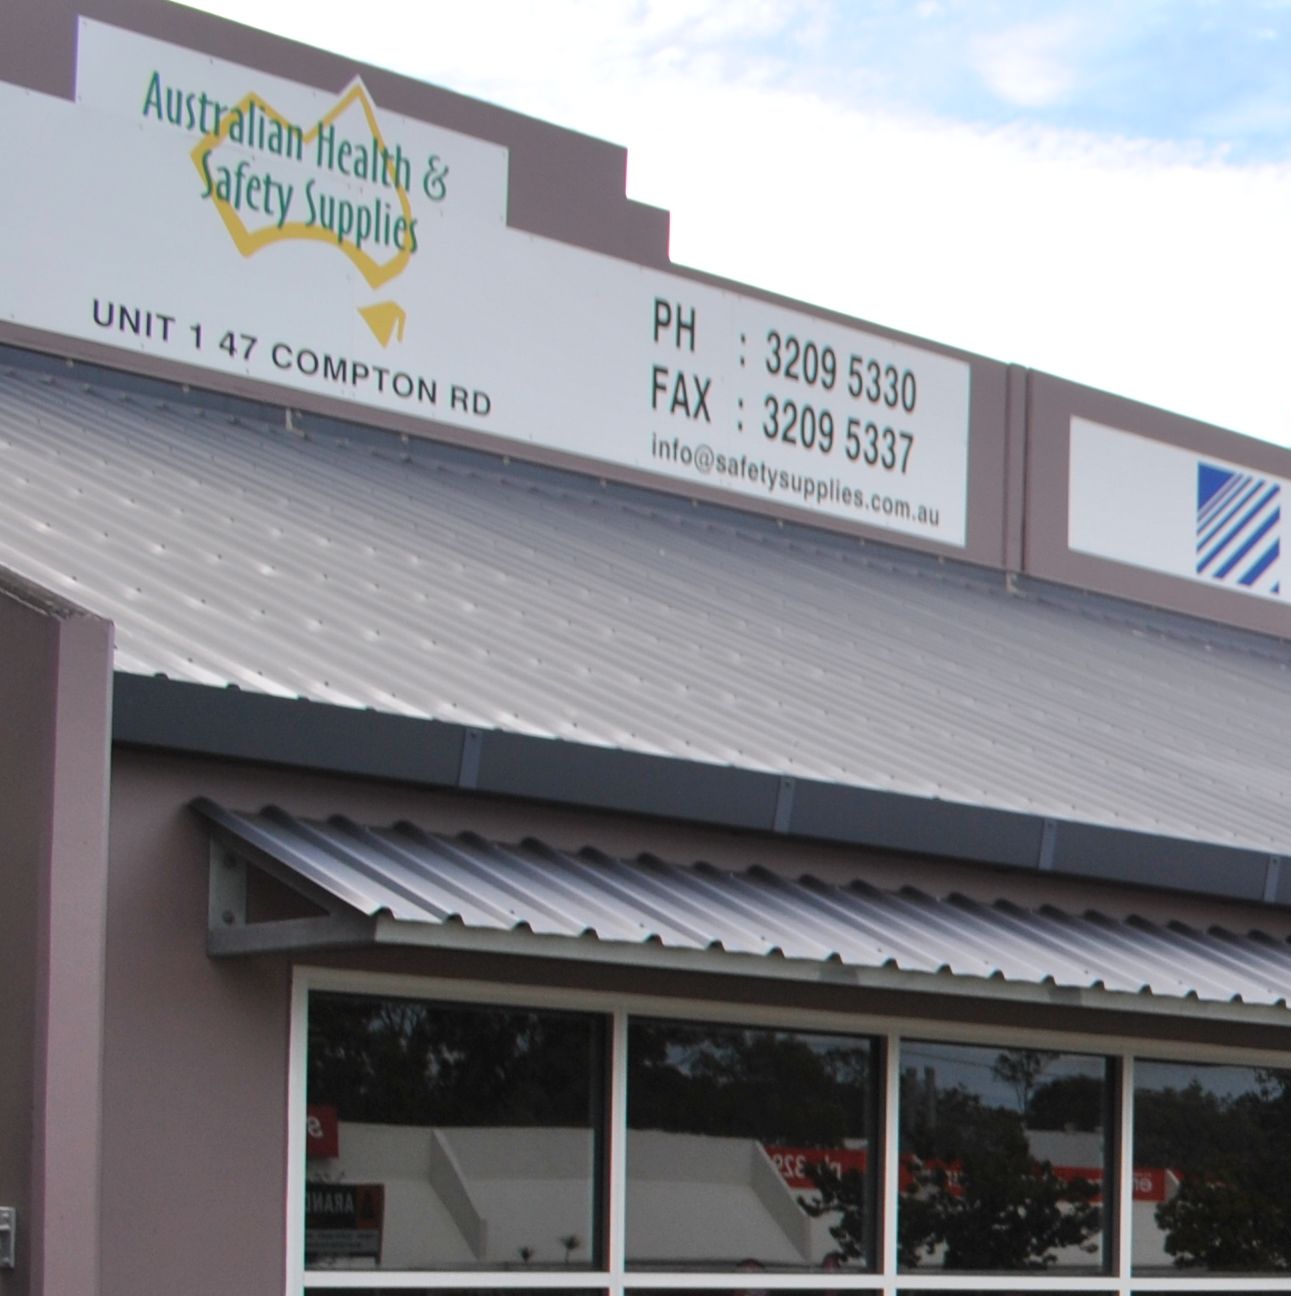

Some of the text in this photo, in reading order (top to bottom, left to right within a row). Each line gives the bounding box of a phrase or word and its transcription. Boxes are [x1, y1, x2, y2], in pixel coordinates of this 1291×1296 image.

[142, 69, 449, 202] Australian Health &
[200, 148, 418, 254] Safety Supplies
[91, 298, 492, 417] UNIT 1 47 COMPTON RD
[653, 296, 696, 353] PH
[765, 329, 837, 390] 3209
[847, 354, 917, 413] 5330
[651, 363, 712, 424] FAX
[762, 392, 835, 454] 3209
[845, 417, 914, 474] 5337
[651, 432, 940, 526] info@safetysupplies.com.au
